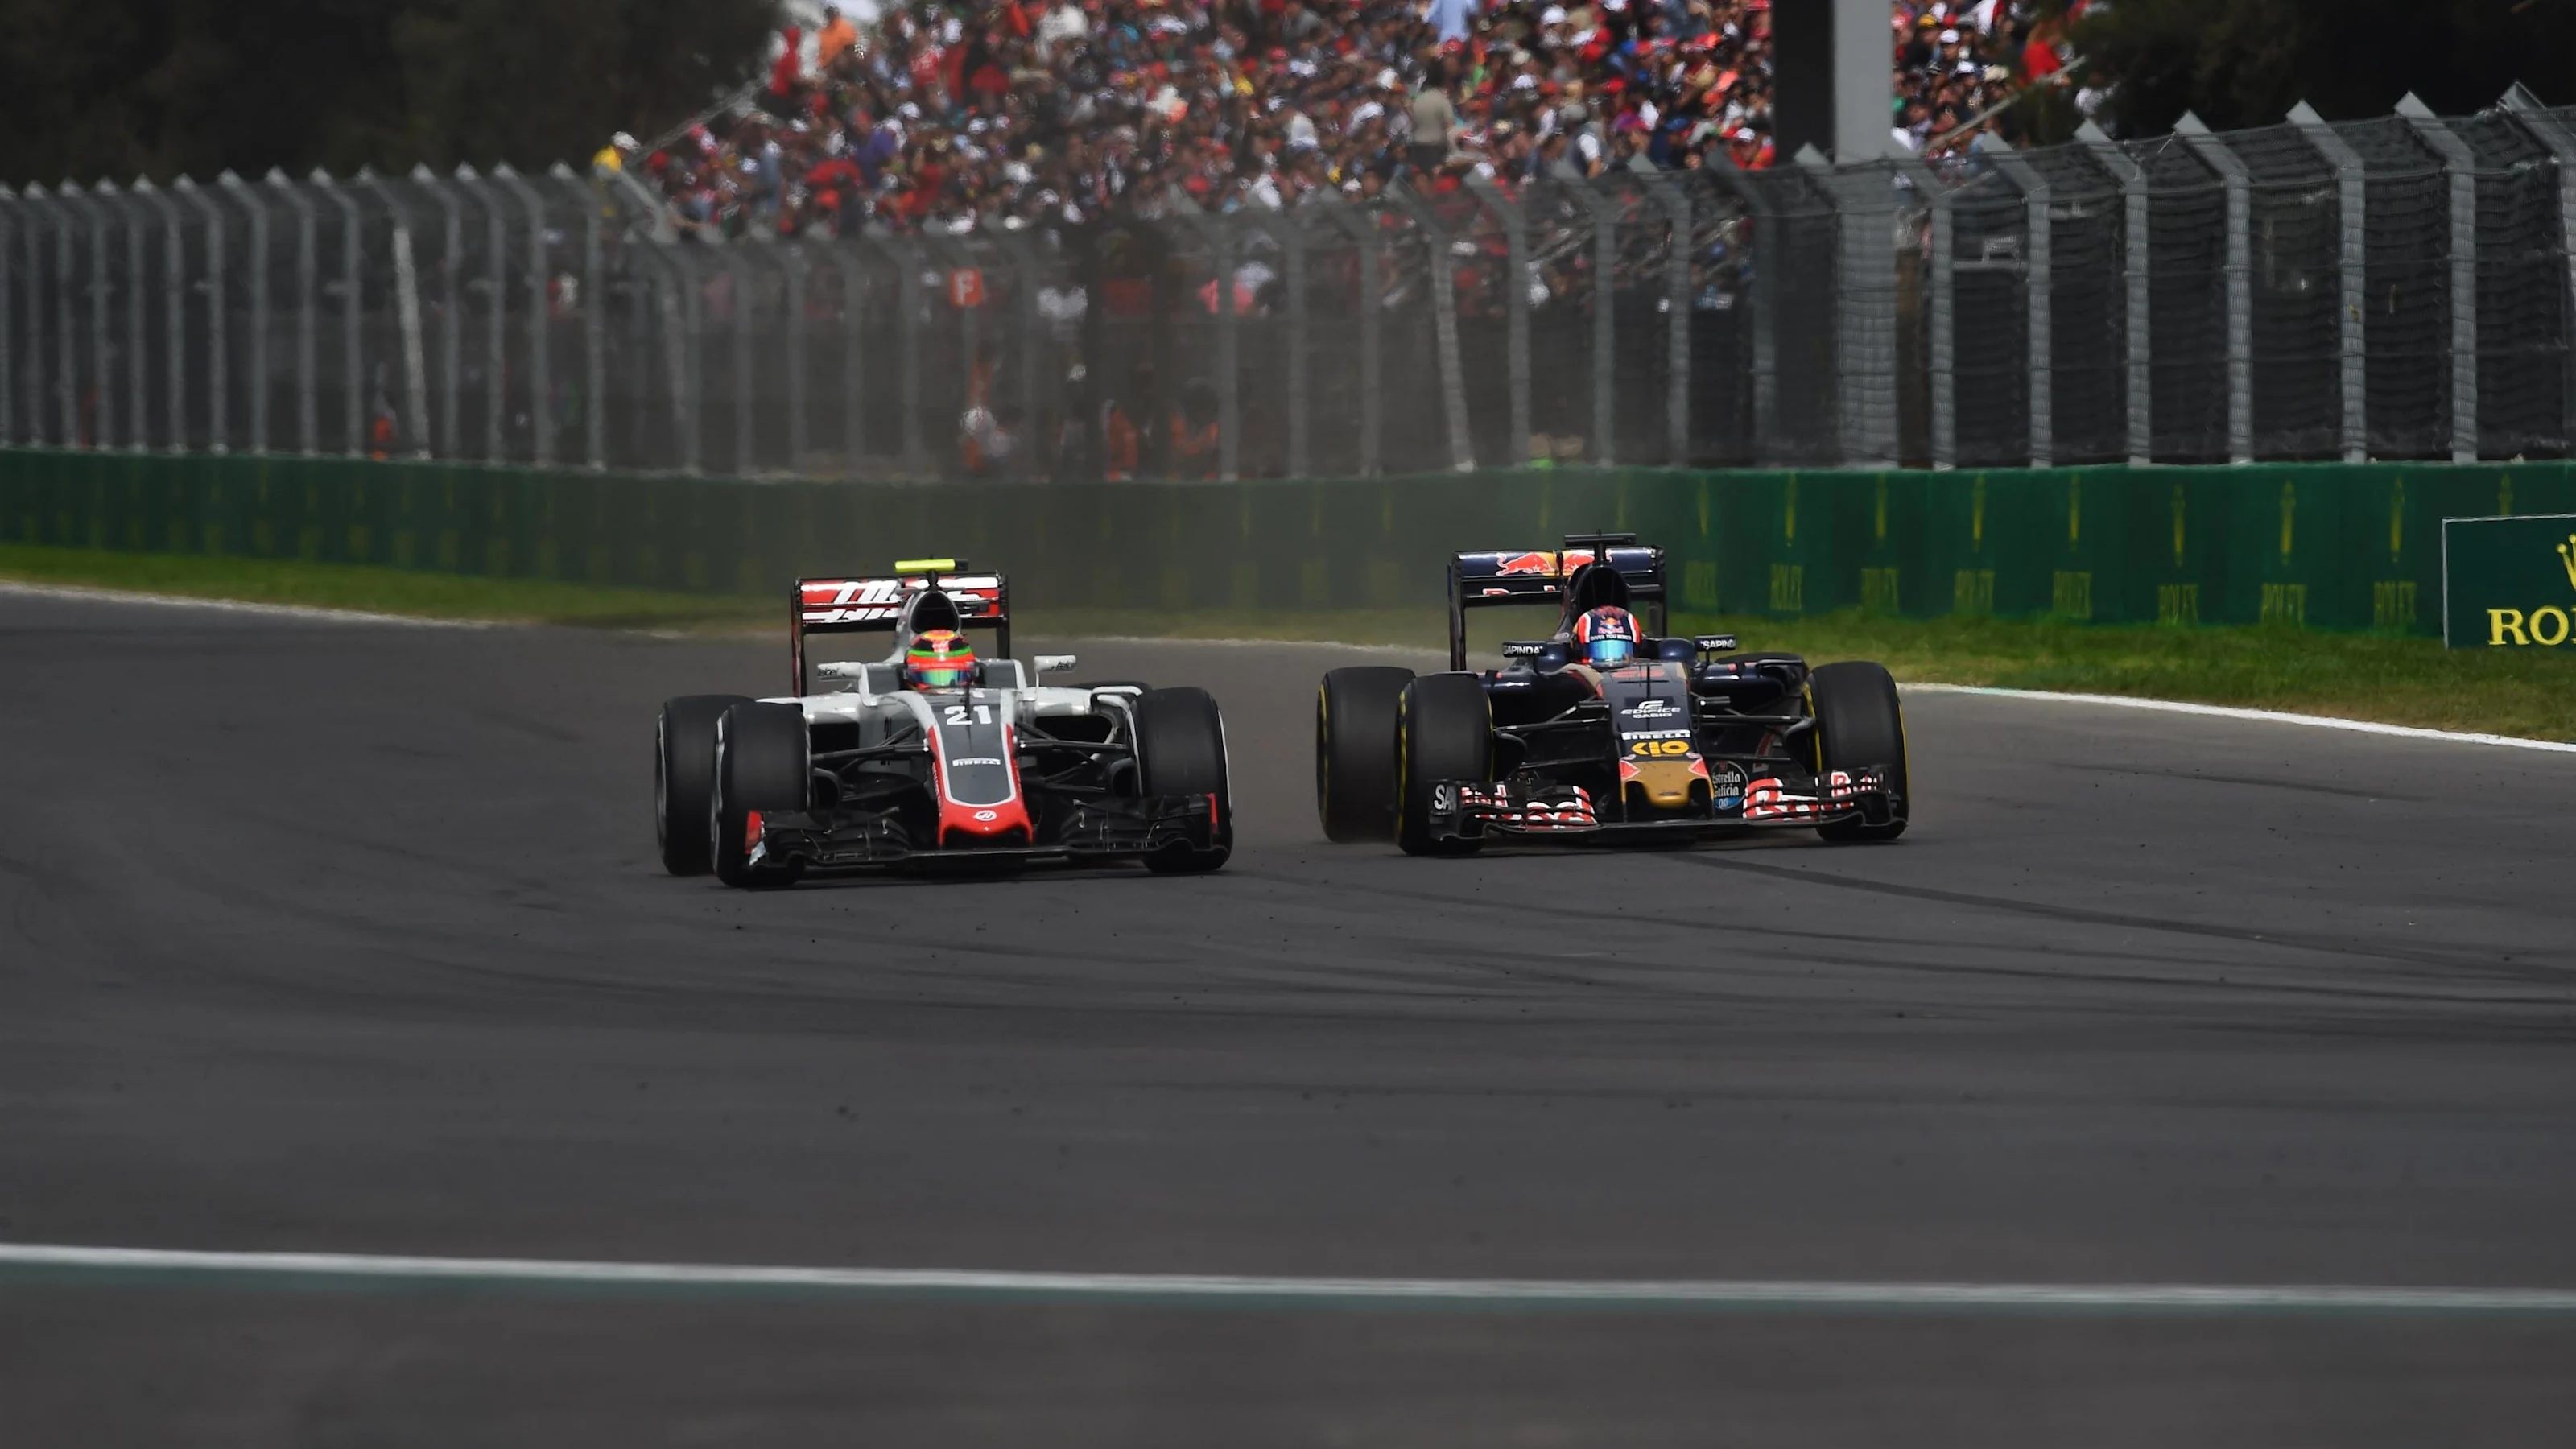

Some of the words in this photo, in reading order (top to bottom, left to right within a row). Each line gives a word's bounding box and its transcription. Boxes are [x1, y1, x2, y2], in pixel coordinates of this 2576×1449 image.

[2486, 605, 2576, 646] RO
[944, 705, 992, 725] 21
[1620, 707, 1682, 715] EDIFICE
[1620, 729, 1691, 741] PIRELLI
[952, 756, 1001, 767] PIRELLI
